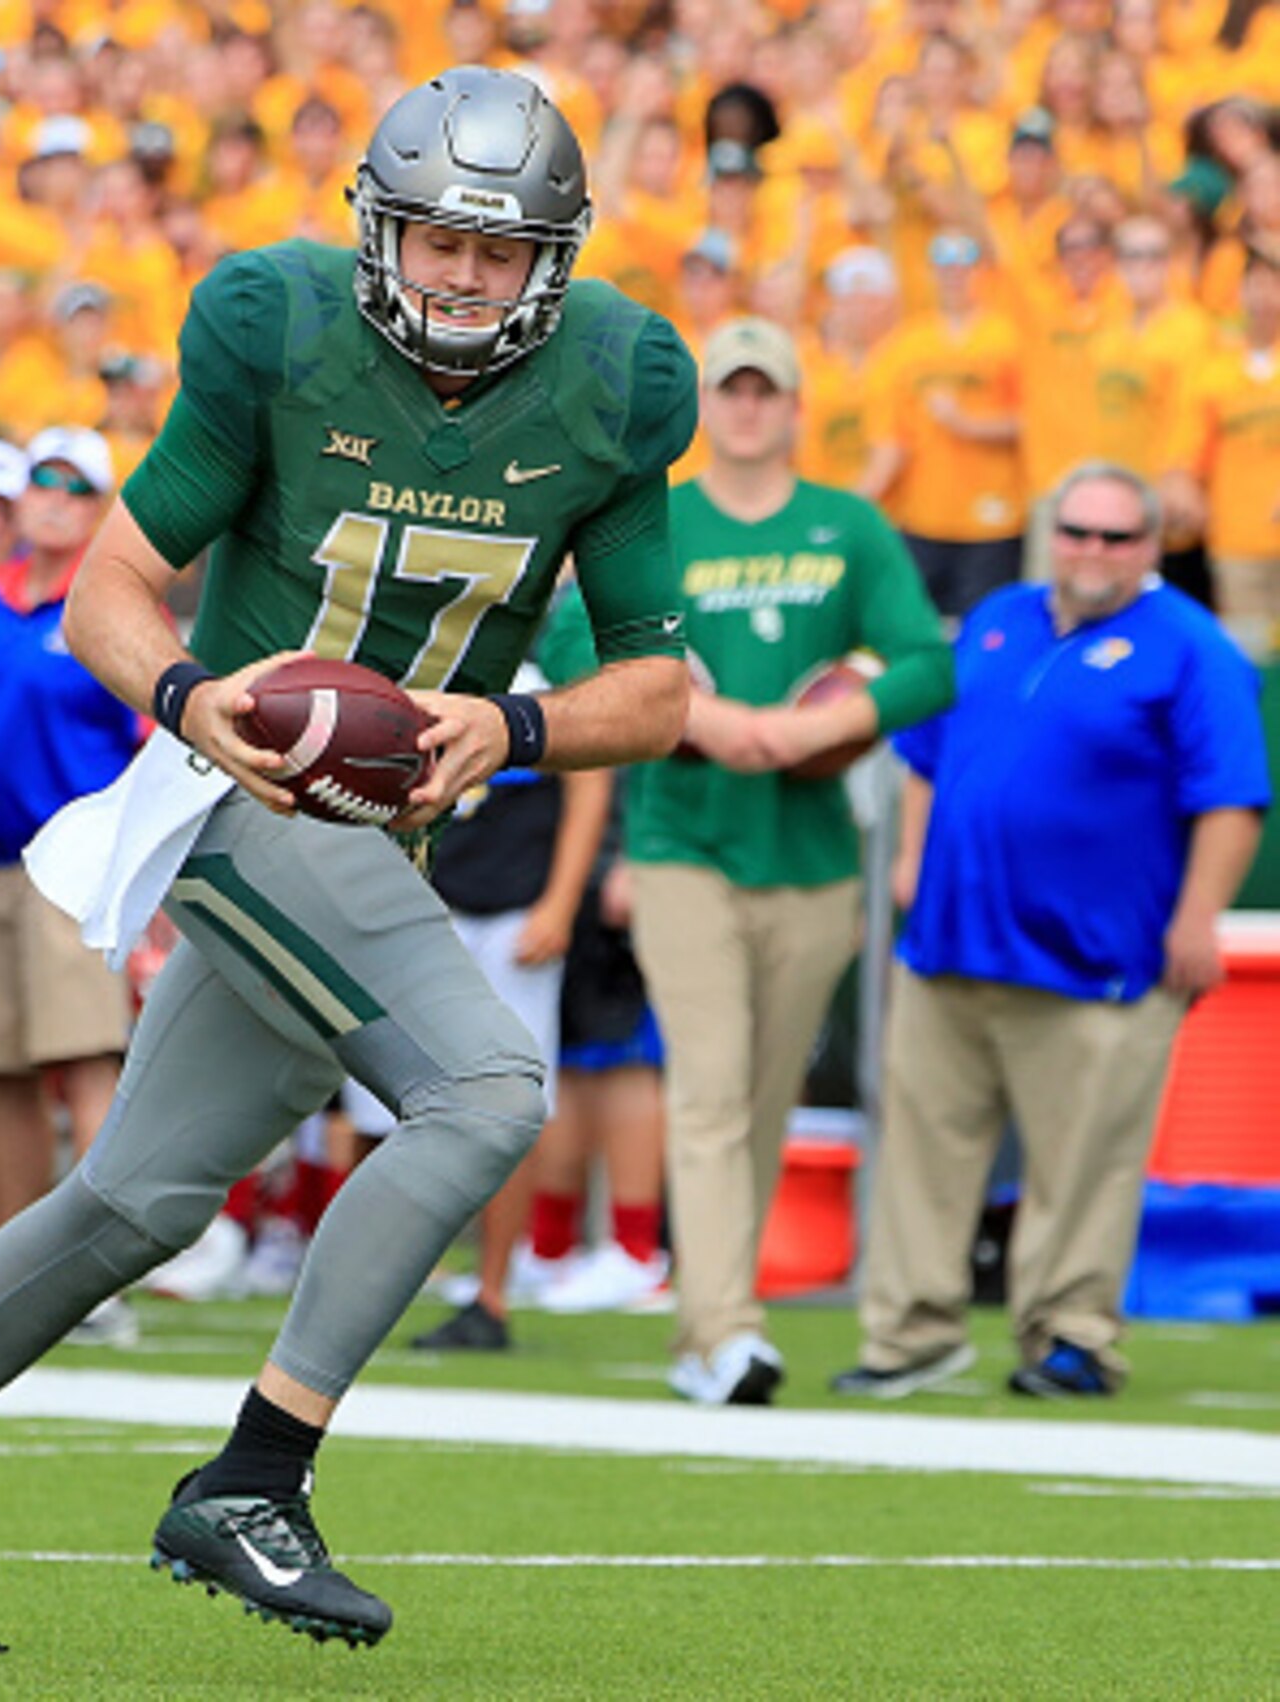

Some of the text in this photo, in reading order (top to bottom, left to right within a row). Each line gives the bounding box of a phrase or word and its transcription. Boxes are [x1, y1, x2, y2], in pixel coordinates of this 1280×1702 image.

[321, 429, 376, 466] XII
[367, 481, 506, 527] BAYLOR
[304, 511, 539, 692] 17
